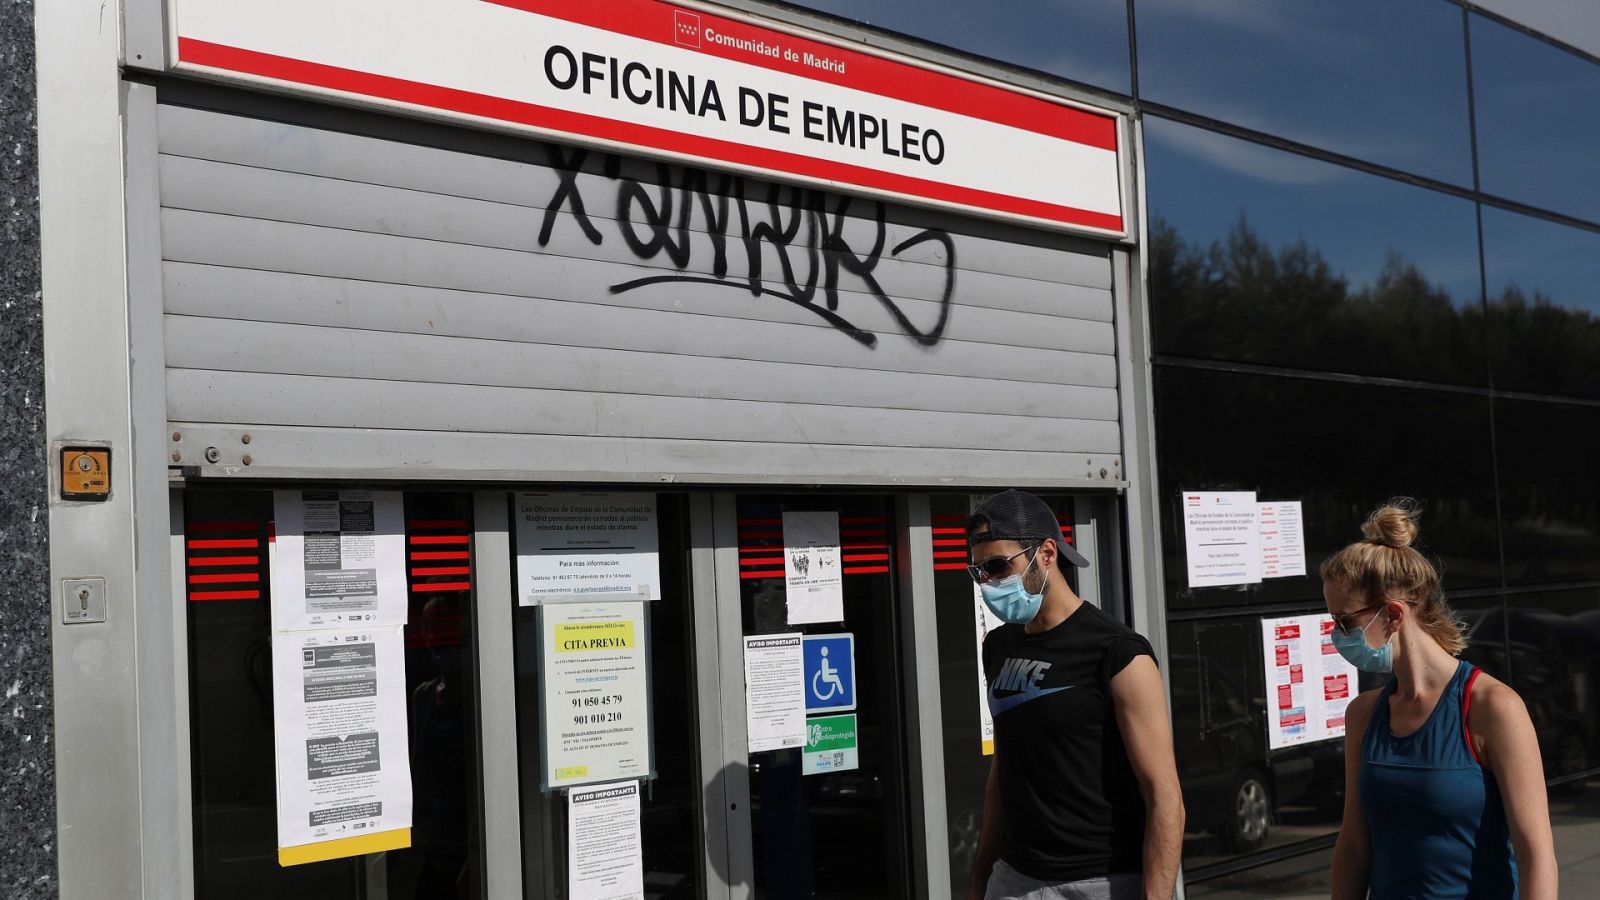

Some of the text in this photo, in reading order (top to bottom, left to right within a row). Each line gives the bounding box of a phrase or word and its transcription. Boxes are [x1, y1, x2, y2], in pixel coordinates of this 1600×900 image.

[705, 28, 845, 74] Comunidad de Madrid
[544, 45, 945, 165] OFICINA DE EMPLEO
[564, 638, 626, 650] CITA PREVIA
[993, 657, 1052, 692] NIKE
[572, 694, 622, 708] 91 050 45 79
[574, 712, 622, 725] 901 010 210
[575, 787, 635, 802] AVISO IMPORTANTE
